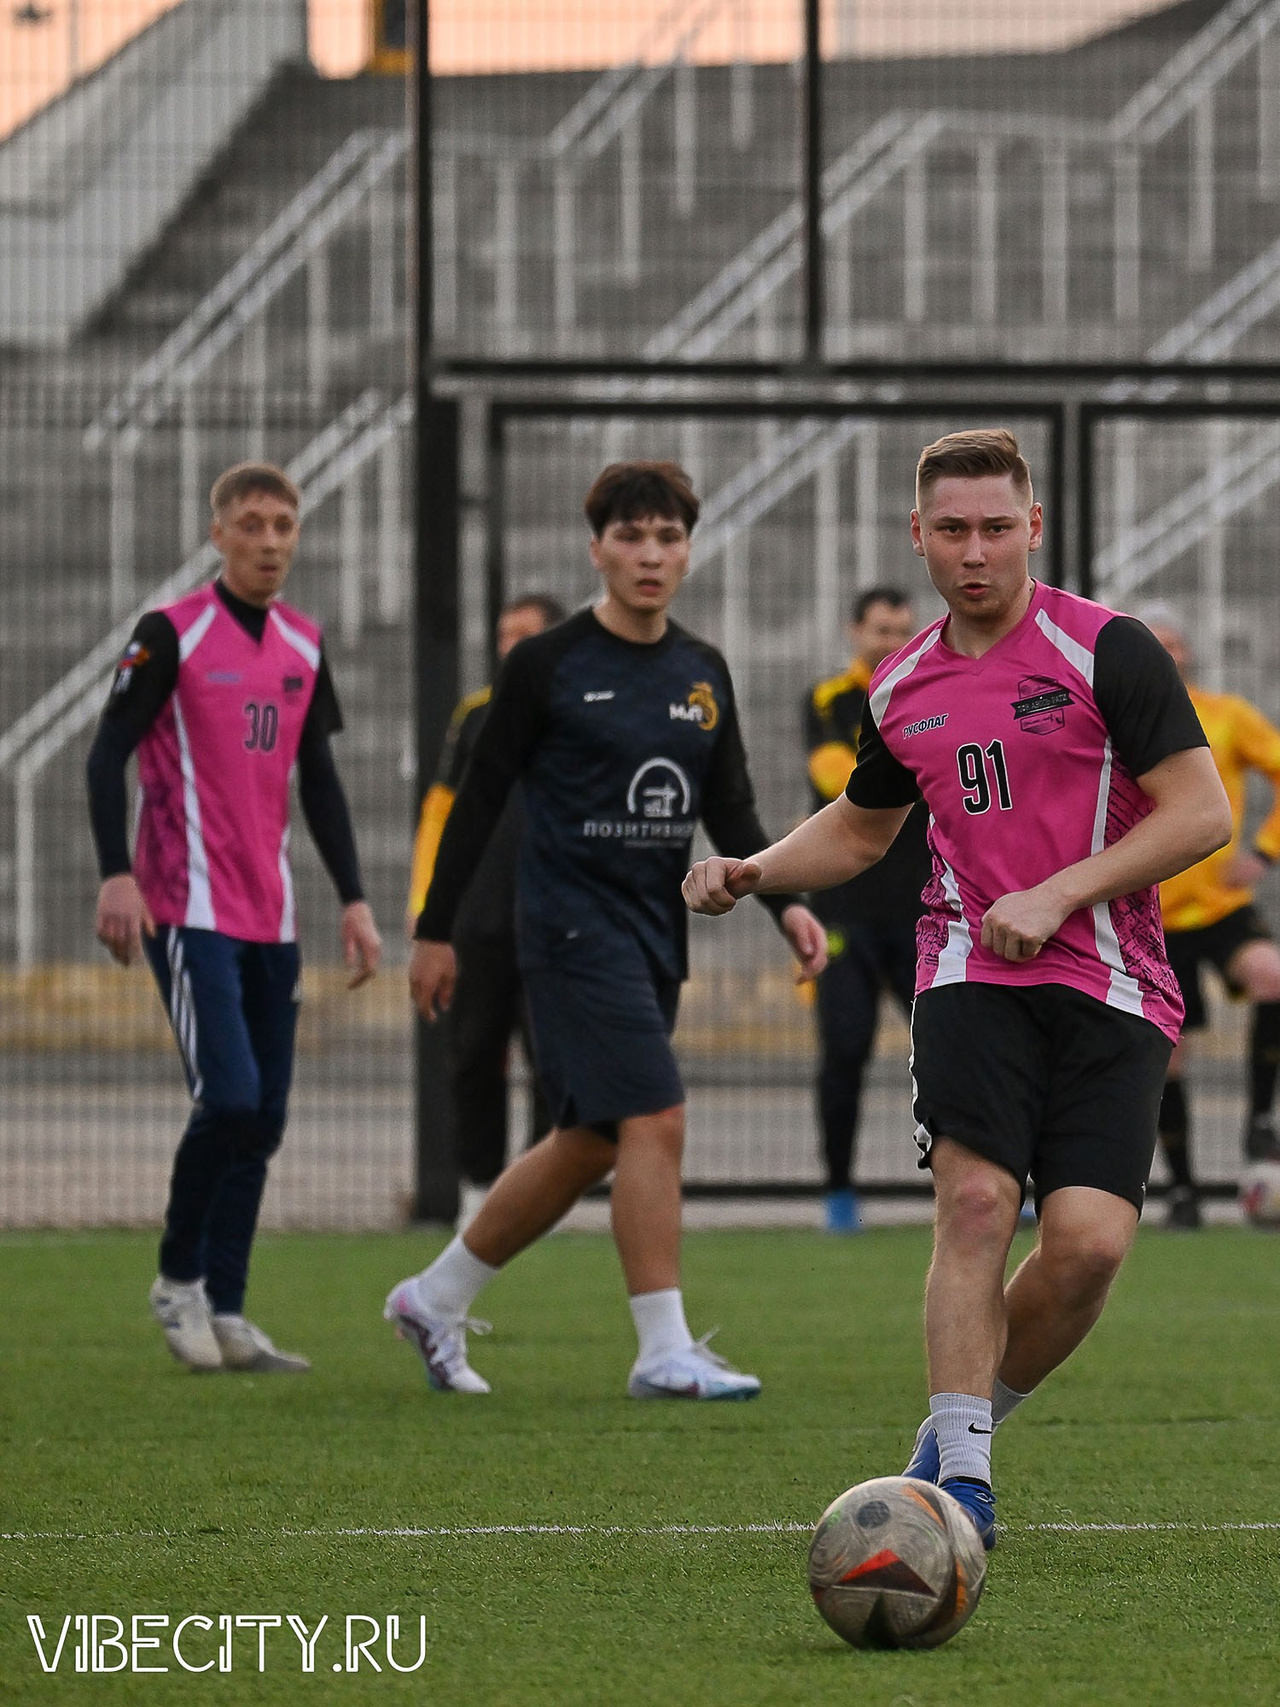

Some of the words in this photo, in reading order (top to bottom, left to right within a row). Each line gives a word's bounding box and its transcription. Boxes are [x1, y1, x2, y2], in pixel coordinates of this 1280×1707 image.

[243, 702, 279, 752] 30
[902, 713, 949, 739] РУСФЛАГ
[957, 739, 1012, 815] 91
